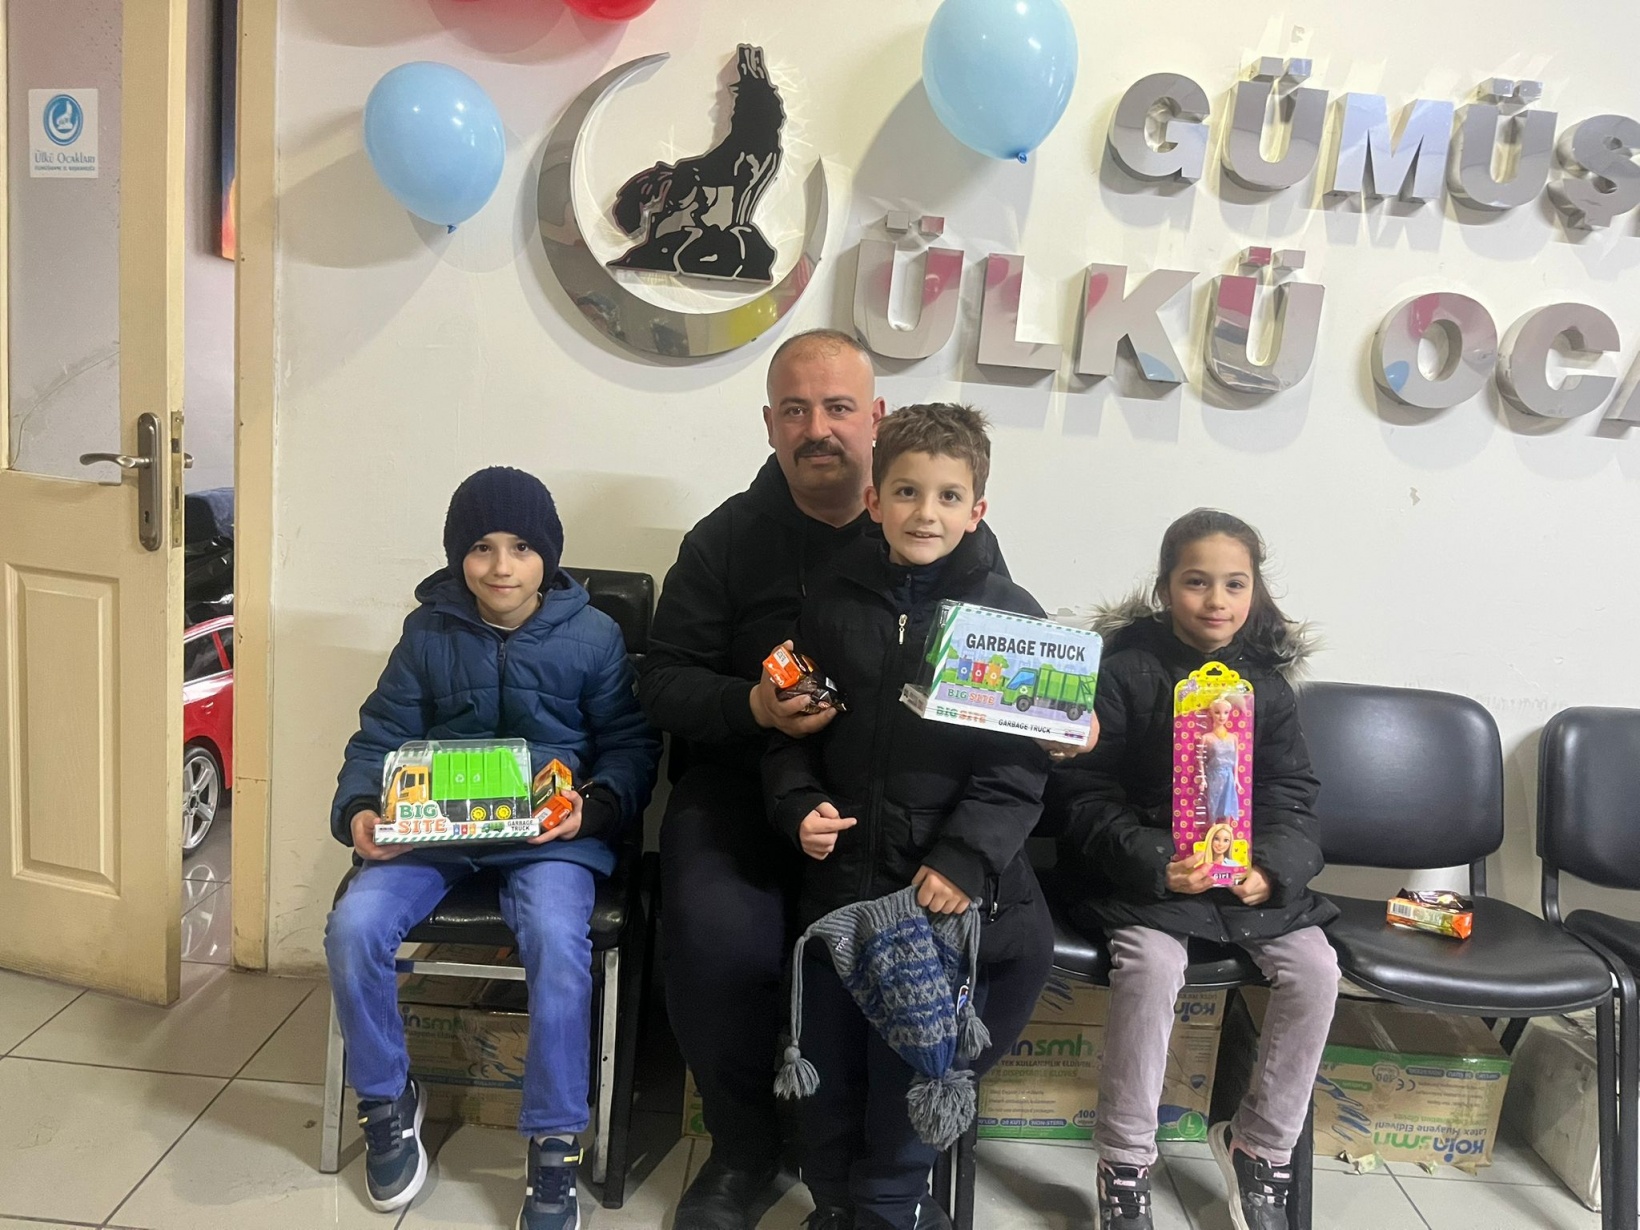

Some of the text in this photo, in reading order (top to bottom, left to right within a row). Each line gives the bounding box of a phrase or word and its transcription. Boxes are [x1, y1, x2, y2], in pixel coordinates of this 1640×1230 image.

[852, 210, 1640, 437] ÜLKÜ OC
[966, 633, 1086, 662] GARBAGE TRUCK
[947, 688, 995, 705] BIG SITE
[936, 706, 958, 718] BIG
[998, 719, 1028, 731] GARBAGE
[1029, 723, 1051, 734] TRUCK
[399, 803, 438, 819] BIG
[398, 819, 448, 836] SITE
[1078, 1109, 1096, 1118] 100
[1187, 1115, 1195, 1127] L
